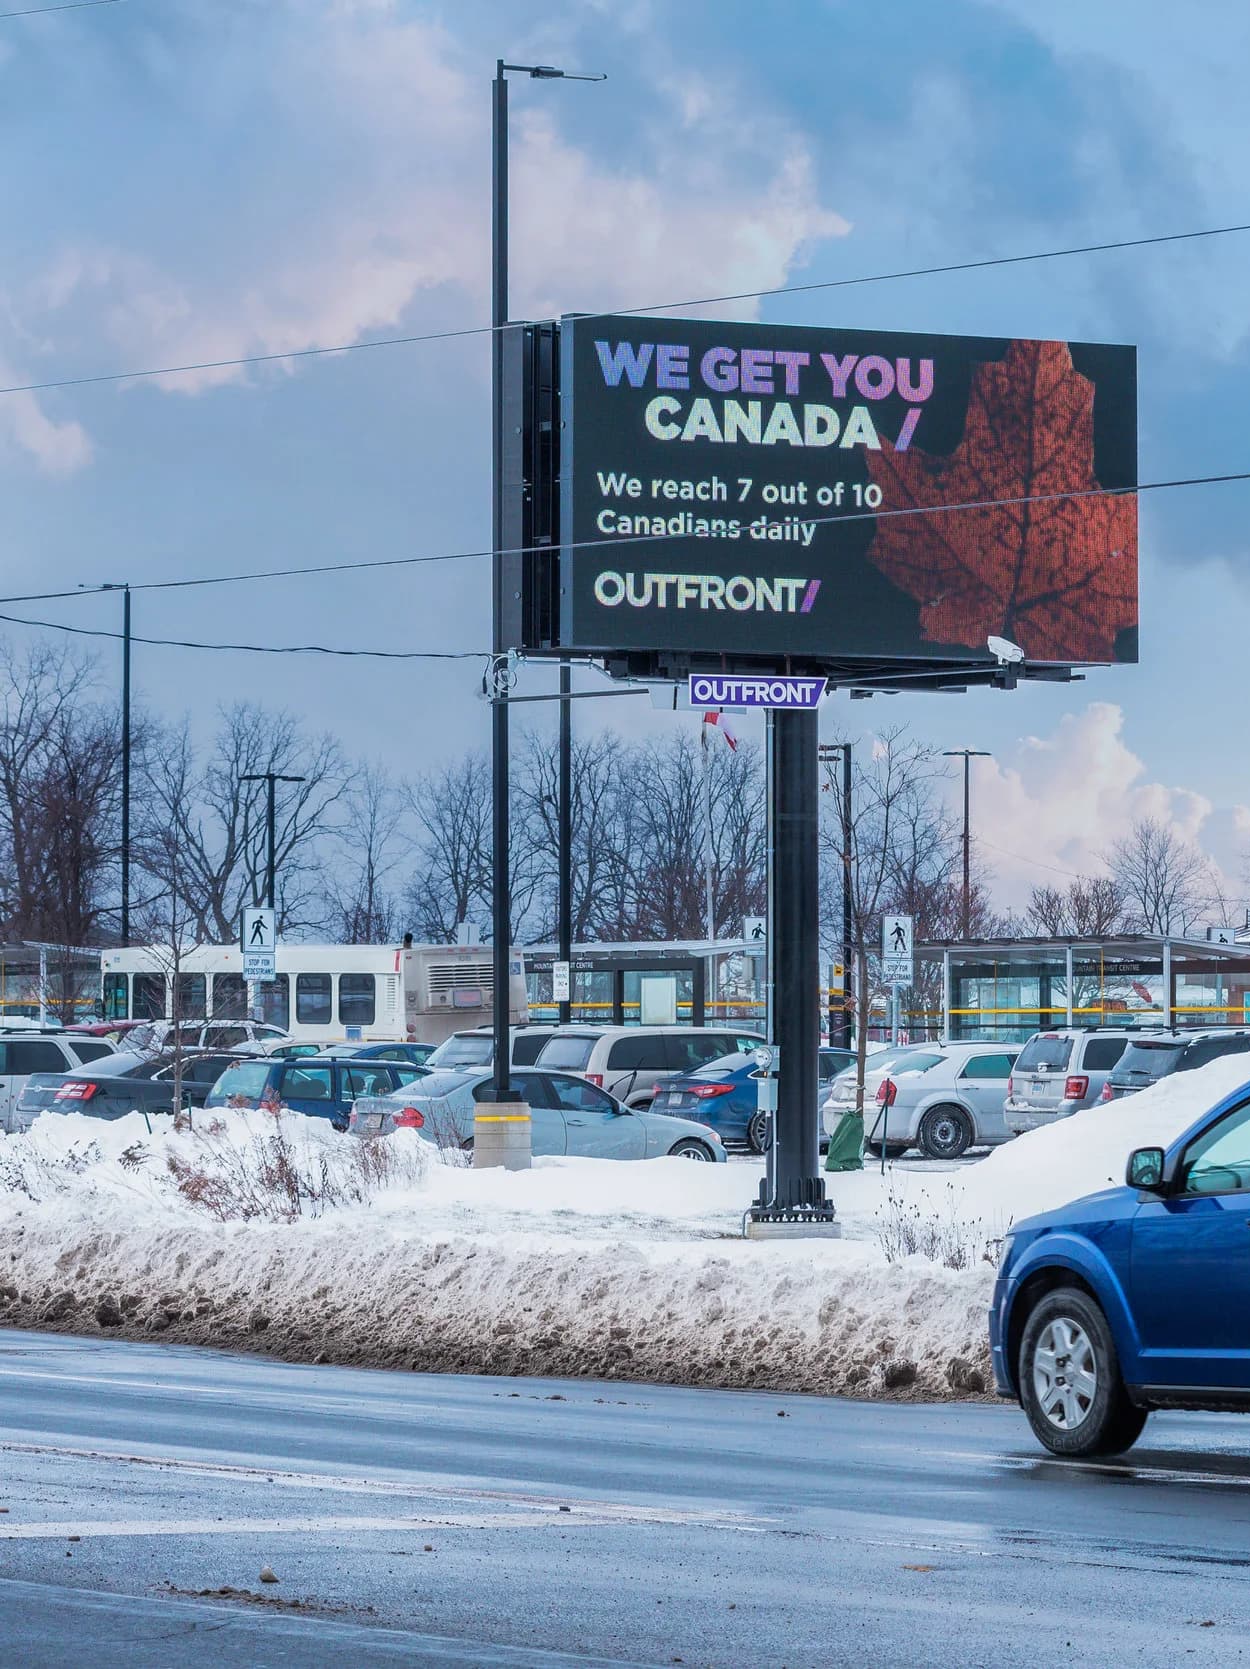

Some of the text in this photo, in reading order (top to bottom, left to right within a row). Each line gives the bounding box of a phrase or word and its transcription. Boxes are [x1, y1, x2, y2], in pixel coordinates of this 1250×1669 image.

[594, 340, 934, 402] WE GET YOU
[645, 395, 882, 450] CANADA
[597, 472, 883, 508] We reach 7 out of 10
[597, 509, 816, 546] Canadians daily
[694, 679, 817, 704] OUTFRONT
[1118, 963, 1141, 972] CENTRE
